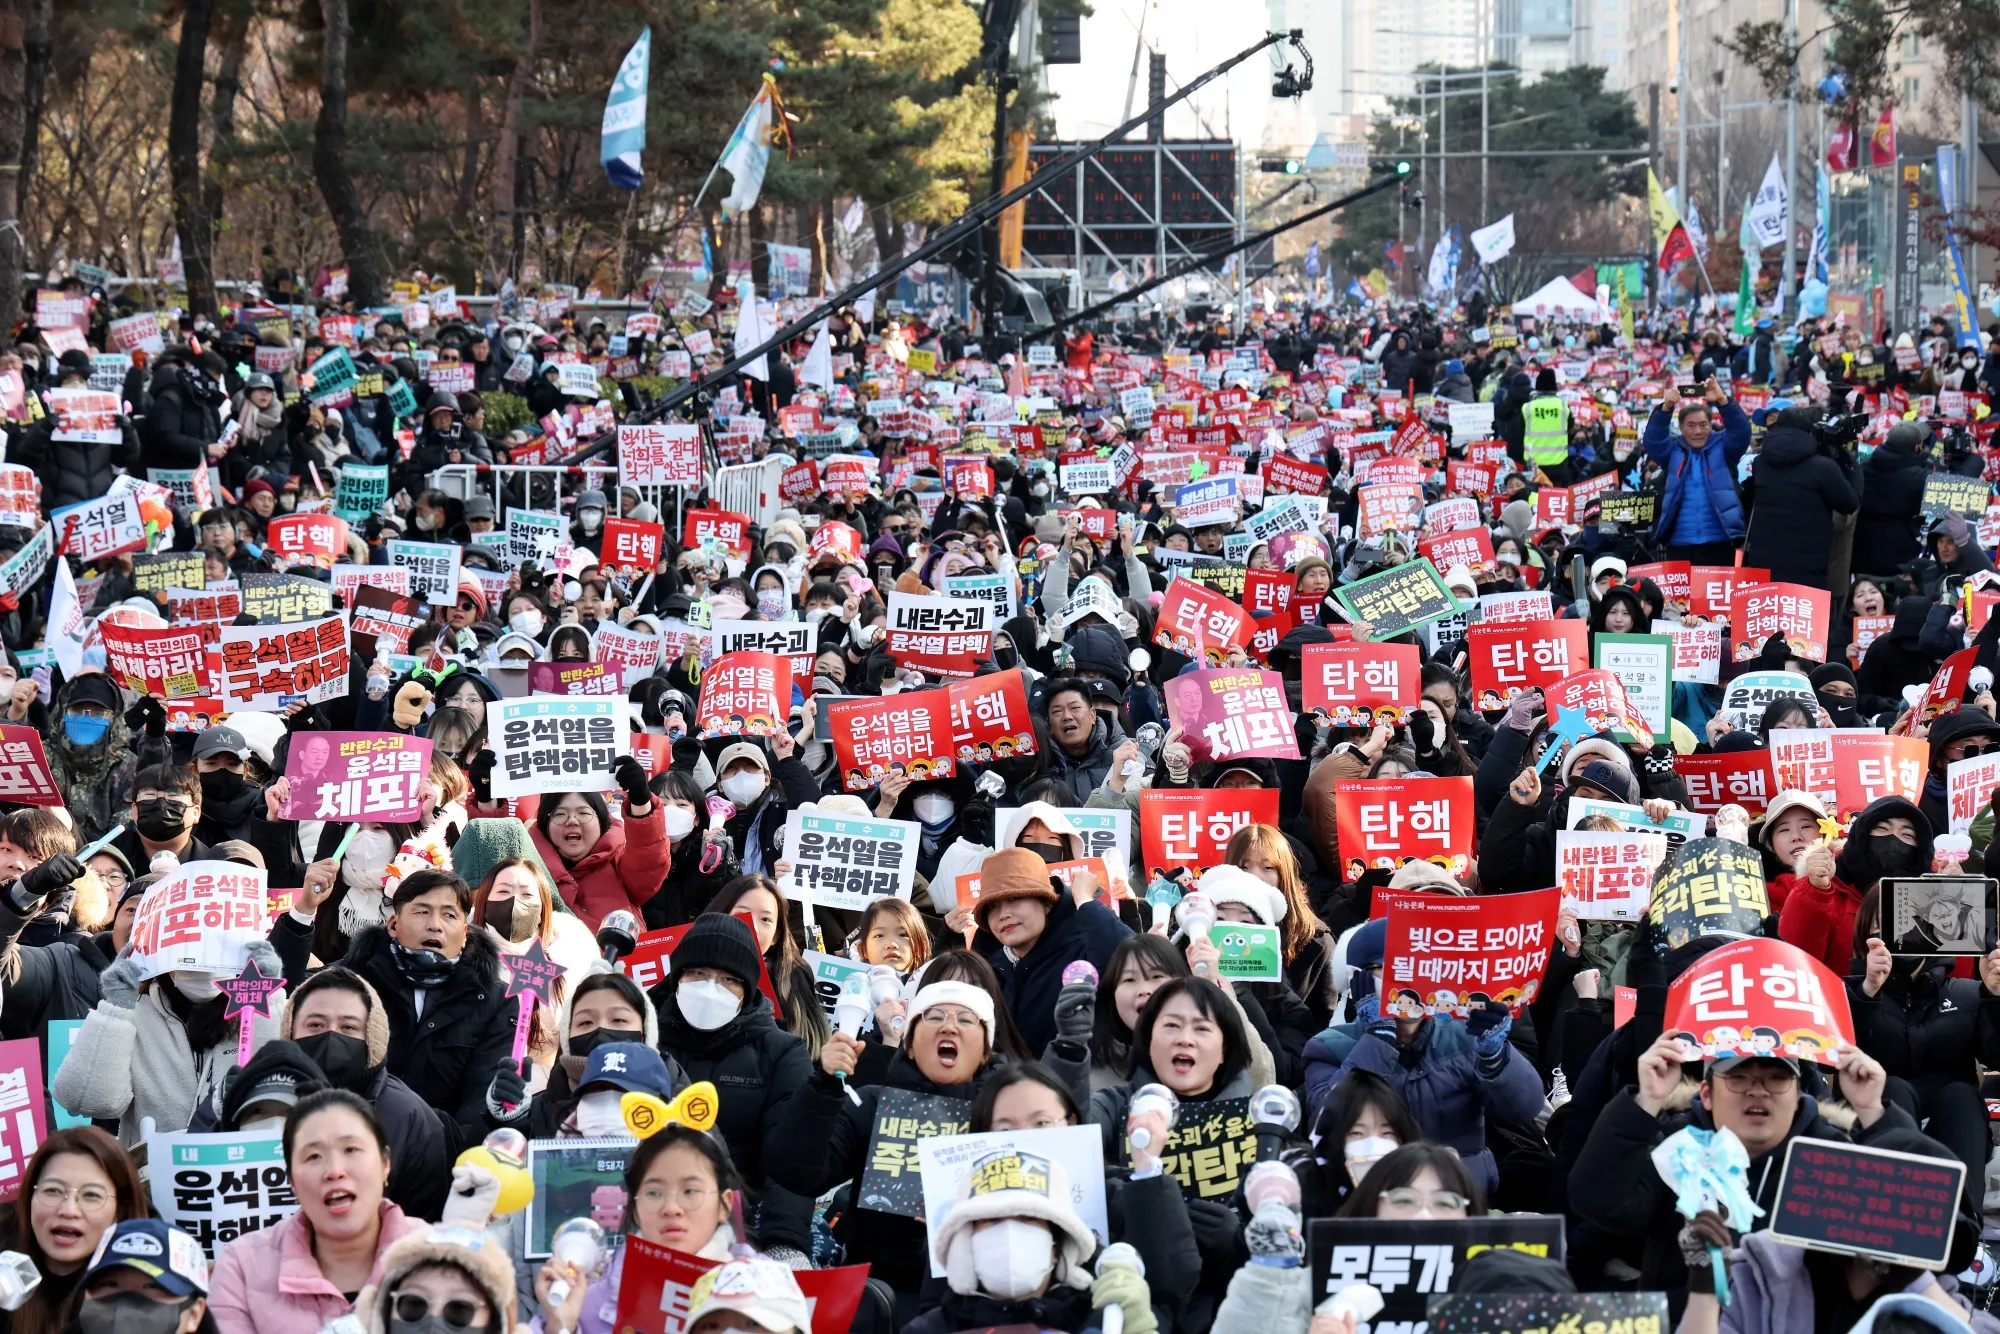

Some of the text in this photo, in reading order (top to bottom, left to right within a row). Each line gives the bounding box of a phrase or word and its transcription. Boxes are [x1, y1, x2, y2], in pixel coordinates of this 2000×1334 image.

[1906, 210, 1918, 272] 국회의사당
[1220, 393, 1241, 406] 탄핵
[622, 430, 664, 445] 역사는
[622, 436, 700, 466] 너희를 절대
[1472, 446, 1501, 464] 탄핵
[625, 460, 702, 482] 잊지 않는다
[782, 468, 810, 483] 윤석열을
[956, 470, 989, 493] 탄핵
[1066, 470, 1108, 480] 윤석열을
[1272, 461, 1324, 484] 내란수괴 윤석열
[1370, 464, 1419, 476] 내란수괴 윤석열
[1456, 467, 1490, 482] 윤석열을
[1066, 480, 1110, 490] 탄핵하라
[1290, 478, 1320, 494] 처단하라
[1456, 478, 1488, 494] 탄핵하라
[1926, 482, 1990, 494] 내란수괴 윤석열
[1428, 498, 1476, 520] 내란범 윤석열
[1924, 490, 1989, 514] 즉각탄핵
[62, 500, 126, 536] 윤석열
[1253, 506, 1302, 539] 윤석열을
[1430, 511, 1478, 534] 체포하라
[280, 522, 334, 552] 탄핵
[696, 520, 742, 548] 탄핵
[812, 526, 851, 550] 탄핵
[616, 532, 656, 564] 탄핵
[1431, 538, 1478, 558] 윤석열을
[136, 558, 204, 577] 내란수괴 윤석열
[1435, 551, 1482, 574] 탄핵하라
[136, 568, 205, 590] 즉각탄핵
[372, 572, 406, 584] 윤석열
[1354, 568, 1428, 608] 내란수괴 윤석열
[1668, 573, 1688, 584] 모이자
[245, 583, 330, 600] 내란수괴 윤석열
[1255, 582, 1290, 612] 탄핵
[1360, 577, 1444, 622] 즉각탄핵
[244, 594, 331, 624] 즉각탄핵
[896, 606, 984, 631] 내란수괴
[1484, 597, 1548, 618] 내란범 윤석열
[1746, 595, 1814, 620] 윤석열을
[1174, 597, 1240, 645] 탄핵
[1492, 626, 1528, 634] www.nanum.com
[1746, 615, 1813, 640] 탄핵하라
[106, 636, 198, 655] 내란동조 국민의힘
[222, 617, 346, 672] 윤석열을
[599, 630, 625, 649] 내란범
[626, 640, 660, 652] 윤석열
[722, 630, 808, 654] 내란수괴
[890, 633, 988, 655] 윤석열 탄핵!
[1695, 630, 1720, 642] 윤석열
[1304, 646, 1324, 654] 나눔문화
[1492, 638, 1569, 682] 탄핵
[228, 647, 351, 703] 구속하라
[560, 664, 605, 684] 반란수괴
[567, 675, 618, 696] 윤석열
[705, 664, 776, 696] 윤석열을
[1208, 672, 1264, 695] 반란수괴
[1323, 660, 1399, 701] 탄핵
[831, 704, 850, 712] 나눔문화
[1222, 686, 1282, 716] 윤석열
[849, 707, 932, 740] 윤석열을
[950, 690, 1010, 742] 탄핵
[504, 716, 616, 749] 윤석열을
[1202, 710, 1295, 760] 체포!
[1835, 738, 1858, 746] 나눔문화
[340, 736, 404, 756] 반란수괴
[852, 734, 934, 766] 탄핵하라
[1776, 740, 1827, 762] 내란범
[346, 750, 422, 779] 윤석열
[504, 746, 618, 780] 탄핵하라
[1339, 784, 1362, 792] 나눔문화
[1858, 754, 1920, 807] 탄핵
[1952, 763, 1996, 792] 내란범
[314, 772, 421, 820] 체포!
[1686, 769, 1767, 813] 탄핵
[1161, 810, 1250, 860] 탄핵
[1360, 798, 1450, 850] 탄핵
[798, 832, 903, 870] 윤석열을
[1563, 844, 1666, 866] 내란범 윤석열
[794, 862, 900, 898] 탄핵하라
[1650, 854, 1762, 898] 내란수괴 윤석열
[140, 874, 260, 919] 내란범 윤석열
[1394, 900, 1480, 912] 나눔문화 www.nanum.com
[1650, 872, 1770, 926] 즉각탄핵
[128, 901, 262, 958] 체포하라
[1408, 920, 1544, 952] 빛으로 모이자
[511, 956, 557, 976] 내란수괴
[1392, 950, 1547, 985] 될 때까지 모이자
[226, 980, 272, 992] 내란의힘
[518, 972, 544, 989] 구속
[234, 992, 262, 1004] 해체
[1690, 962, 1826, 1026] 탄핵
[719, 1075, 746, 1084] GOLDEN
[879, 1117, 959, 1138] 내란수괴
[597, 1160, 624, 1172] 윤돼지
[1326, 1244, 1454, 1294] 모두가
